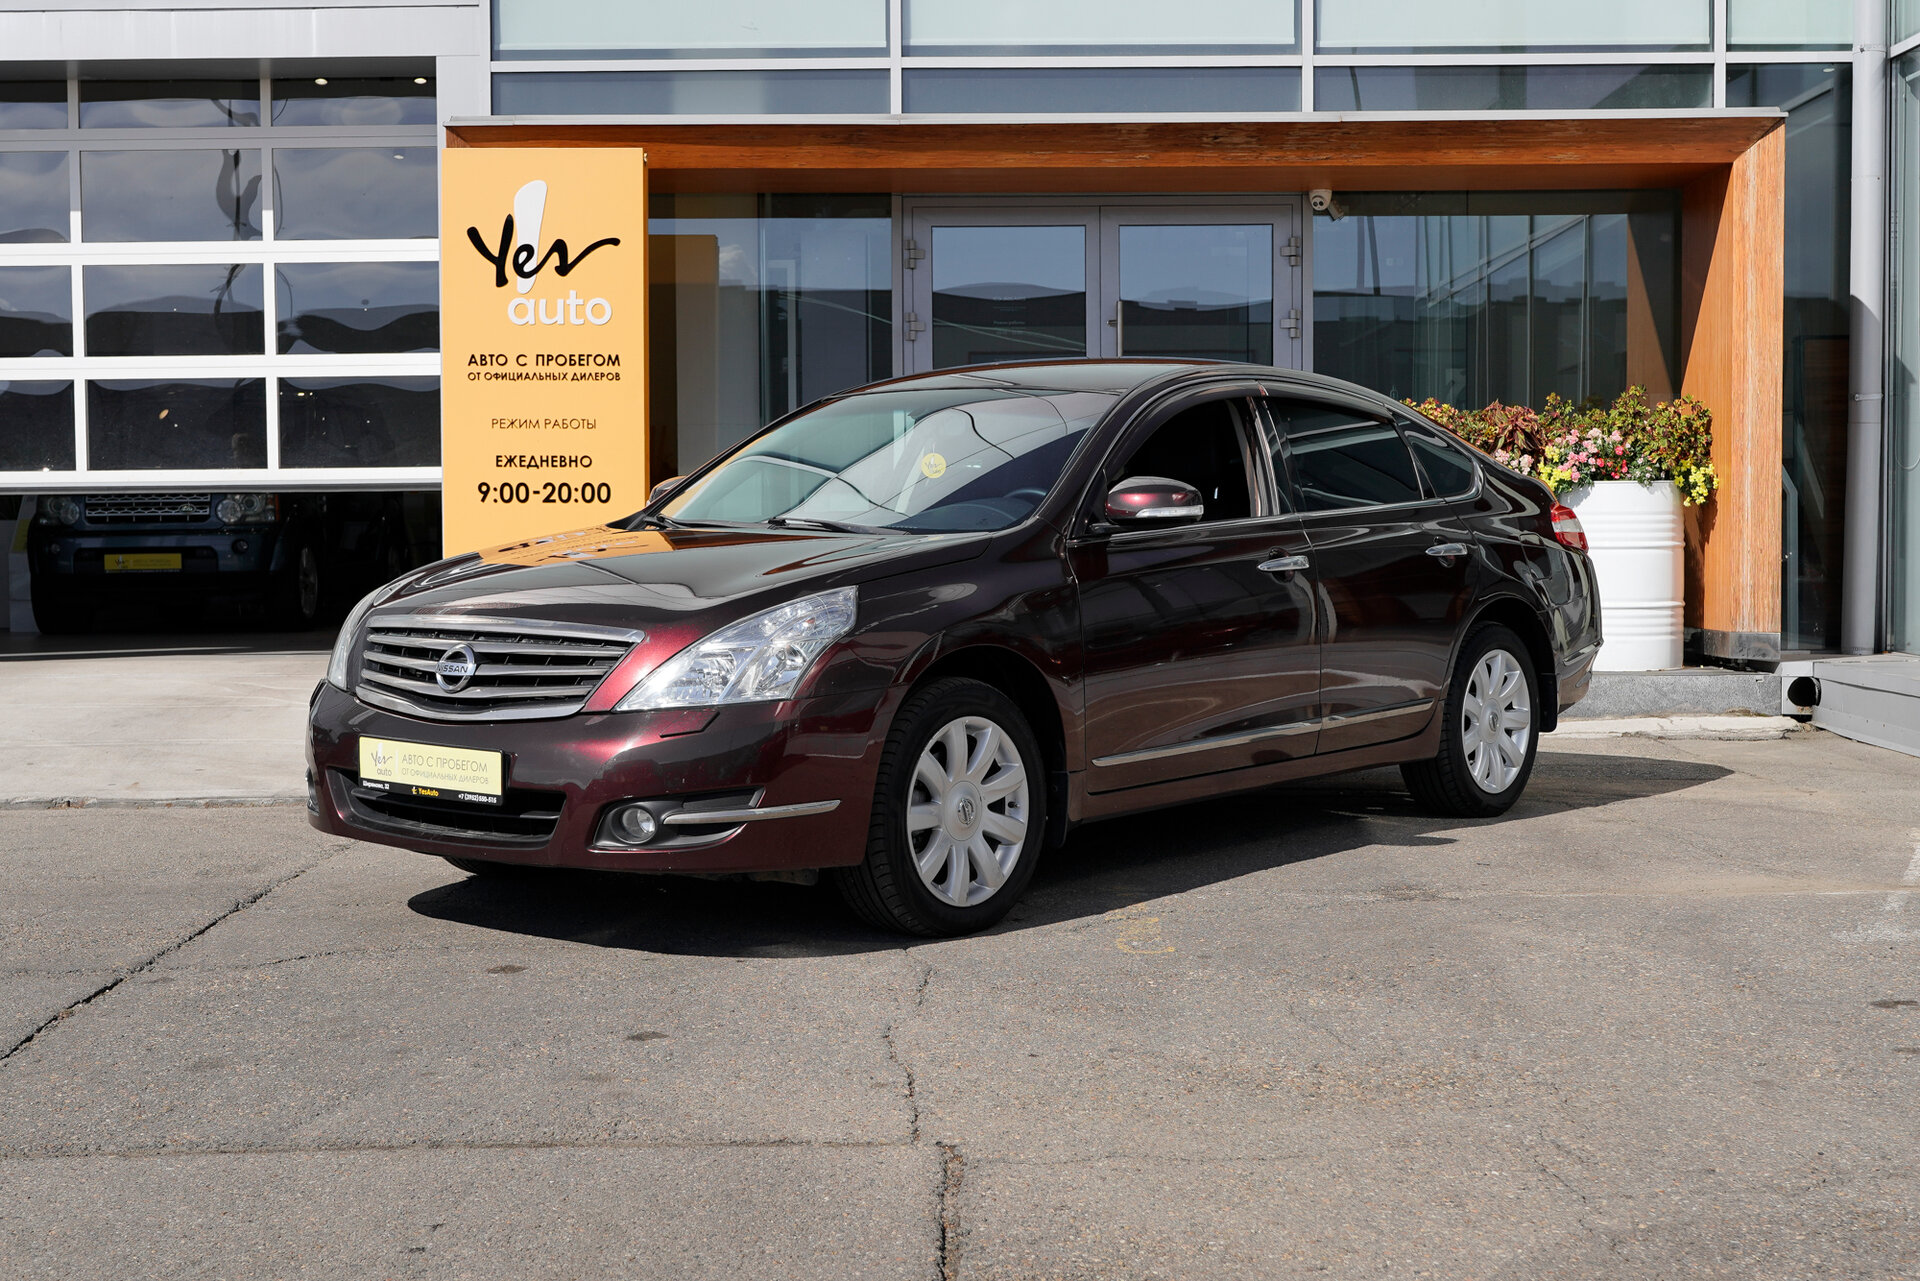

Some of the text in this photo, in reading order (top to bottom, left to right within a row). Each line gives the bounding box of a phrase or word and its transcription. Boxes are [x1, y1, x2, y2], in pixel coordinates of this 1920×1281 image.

[466, 213, 621, 288] Yes
[507, 289, 613, 326] auto
[467, 353, 621, 367] АВТО С ПРОБЕГОМ
[467, 371, 621, 383] ОТ ОФИЦИАЛЬНЫХ ДИЛЕРОВ
[491, 418, 597, 430] РЕЖИМ РАБОТЫ
[495, 454, 593, 469] ЕЖЕДНЕВНО
[477, 481, 612, 504] 9:00-20:00
[436, 665, 468, 673] NISSAN
[401, 754, 488, 772] АВТО С ПРОБЕГОМ
[376, 768, 392, 777] auto
[401, 767, 489, 785] ОТ ОФИЦИАЛЬНЫХ ДИЛЕРОВ
[418, 787, 439, 797] YesAuto
